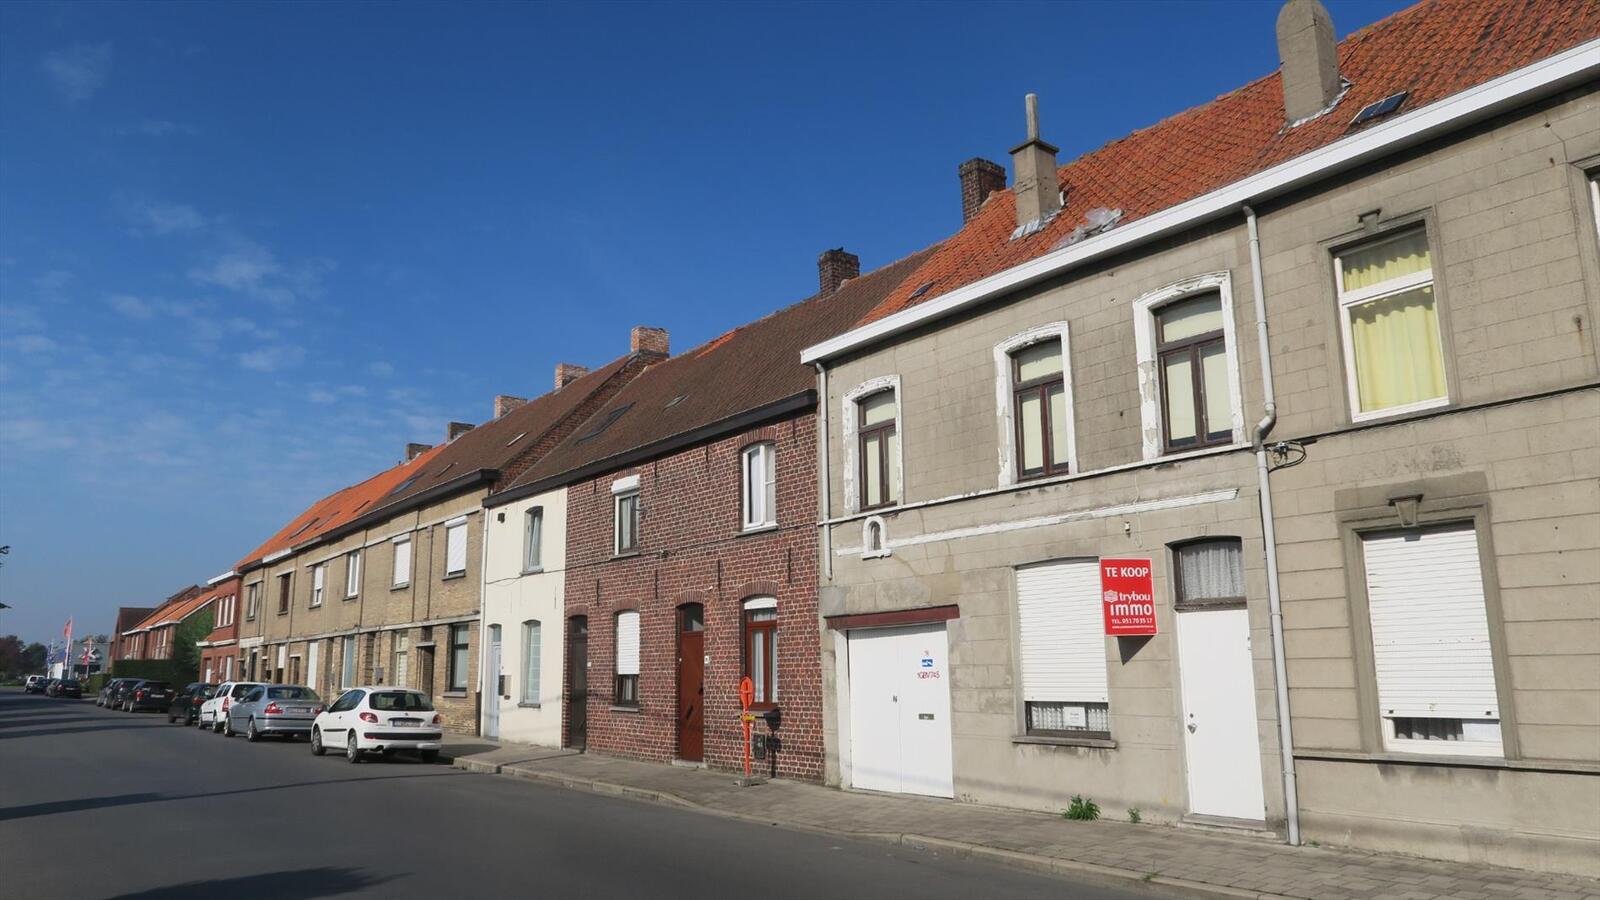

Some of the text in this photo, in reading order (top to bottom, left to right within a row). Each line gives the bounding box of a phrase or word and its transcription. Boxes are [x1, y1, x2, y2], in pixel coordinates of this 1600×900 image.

[1104, 566, 1149, 577] TE KOOP
[1119, 590, 1151, 604] trybou
[1110, 603, 1152, 616] immo
